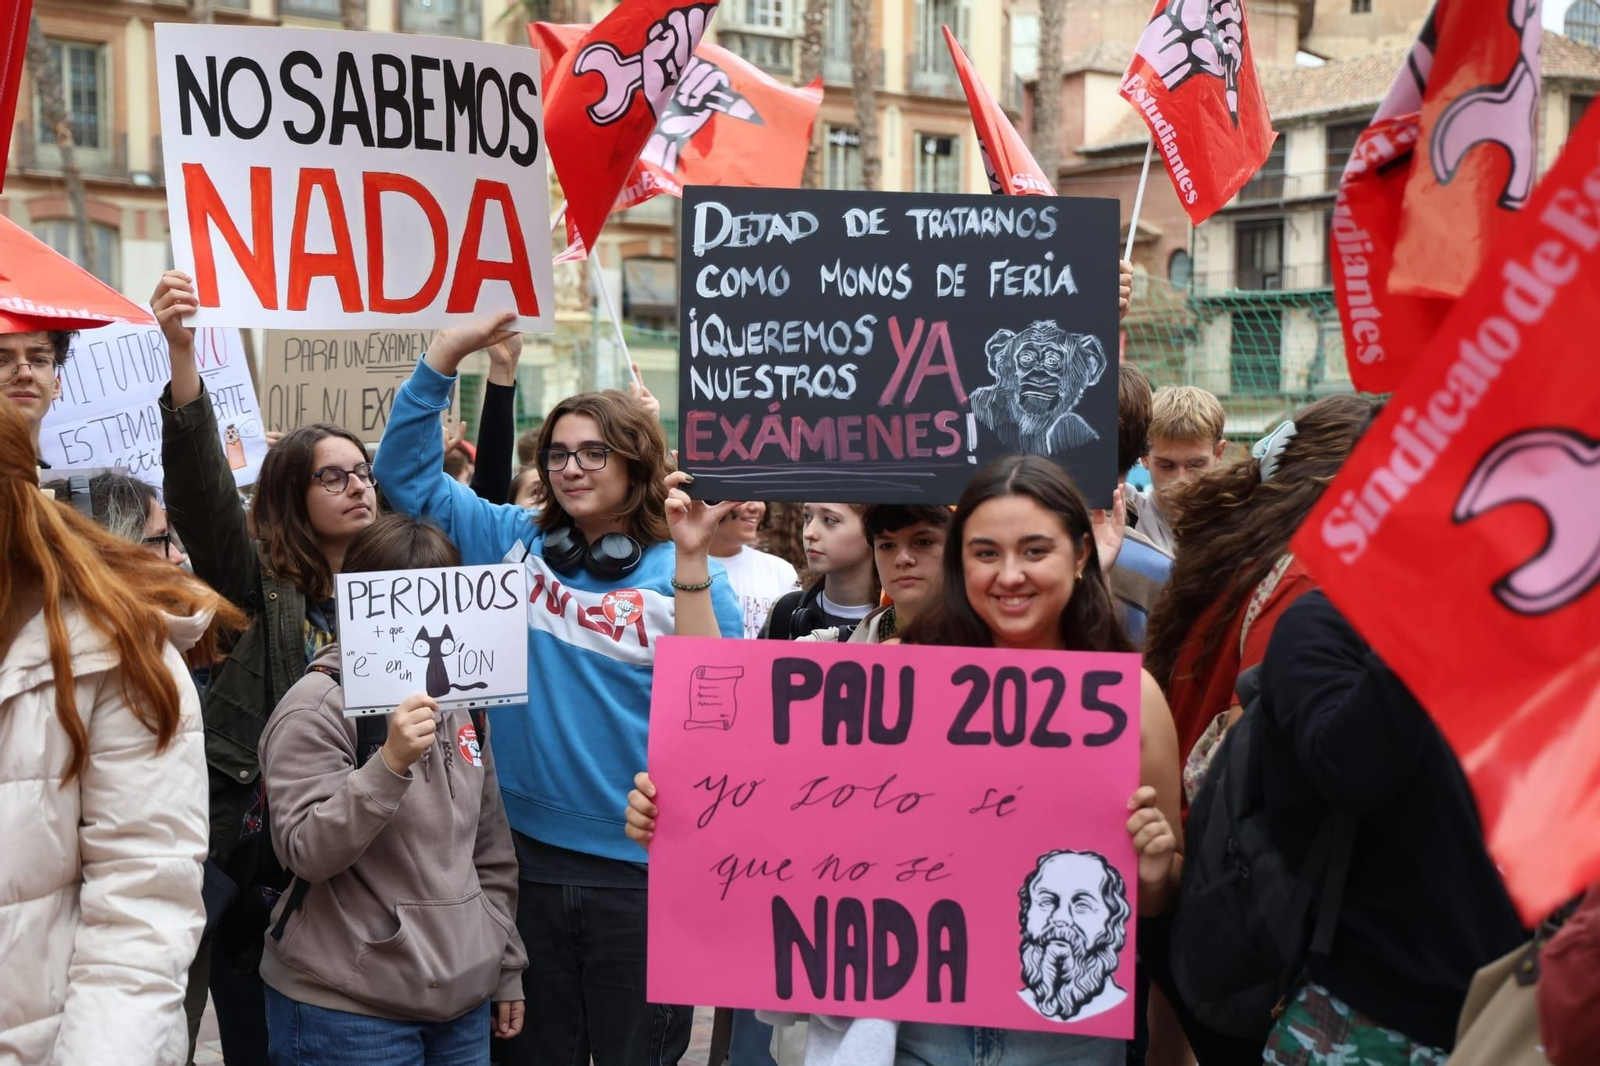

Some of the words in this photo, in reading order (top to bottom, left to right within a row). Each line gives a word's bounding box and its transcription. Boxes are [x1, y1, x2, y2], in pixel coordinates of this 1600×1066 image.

[175, 54, 272, 140] NO
[280, 51, 538, 167] SABEMOS
[1122, 73, 1198, 205] Estudiantes
[182, 162, 540, 317] NADA
[694, 202, 819, 257] DEJAD
[842, 208, 890, 238] DE
[905, 205, 1059, 241] TRATARNOS
[696, 264, 791, 298] COMO
[820, 259, 912, 300] MONOS
[936, 263, 967, 297] DE
[89, 330, 171, 397] FUTUR
[284, 337, 338, 373] PARA
[690, 363, 858, 401] NUESTROS
[878, 316, 968, 407] YA
[323, 387, 347, 431] NI
[1321, 315, 1520, 565] Sindicato
[1503, 240, 1580, 325] de
[59, 426, 93, 465] ES
[685, 401, 978, 465] EXÁMENES!
[347, 569, 518, 620] PERDIDOS
[389, 626, 405, 643] que
[386, 660, 402, 674] en
[771, 656, 915, 746] PAU
[946, 664, 1128, 748] 2025
[693, 774, 766, 829] yo
[790, 774, 935, 813] solo
[969, 786, 1024, 818] sé
[709, 853, 794, 900] que
[812, 855, 877, 882] no
[895, 853, 953, 882] sé
[771, 895, 968, 1003] NADA
